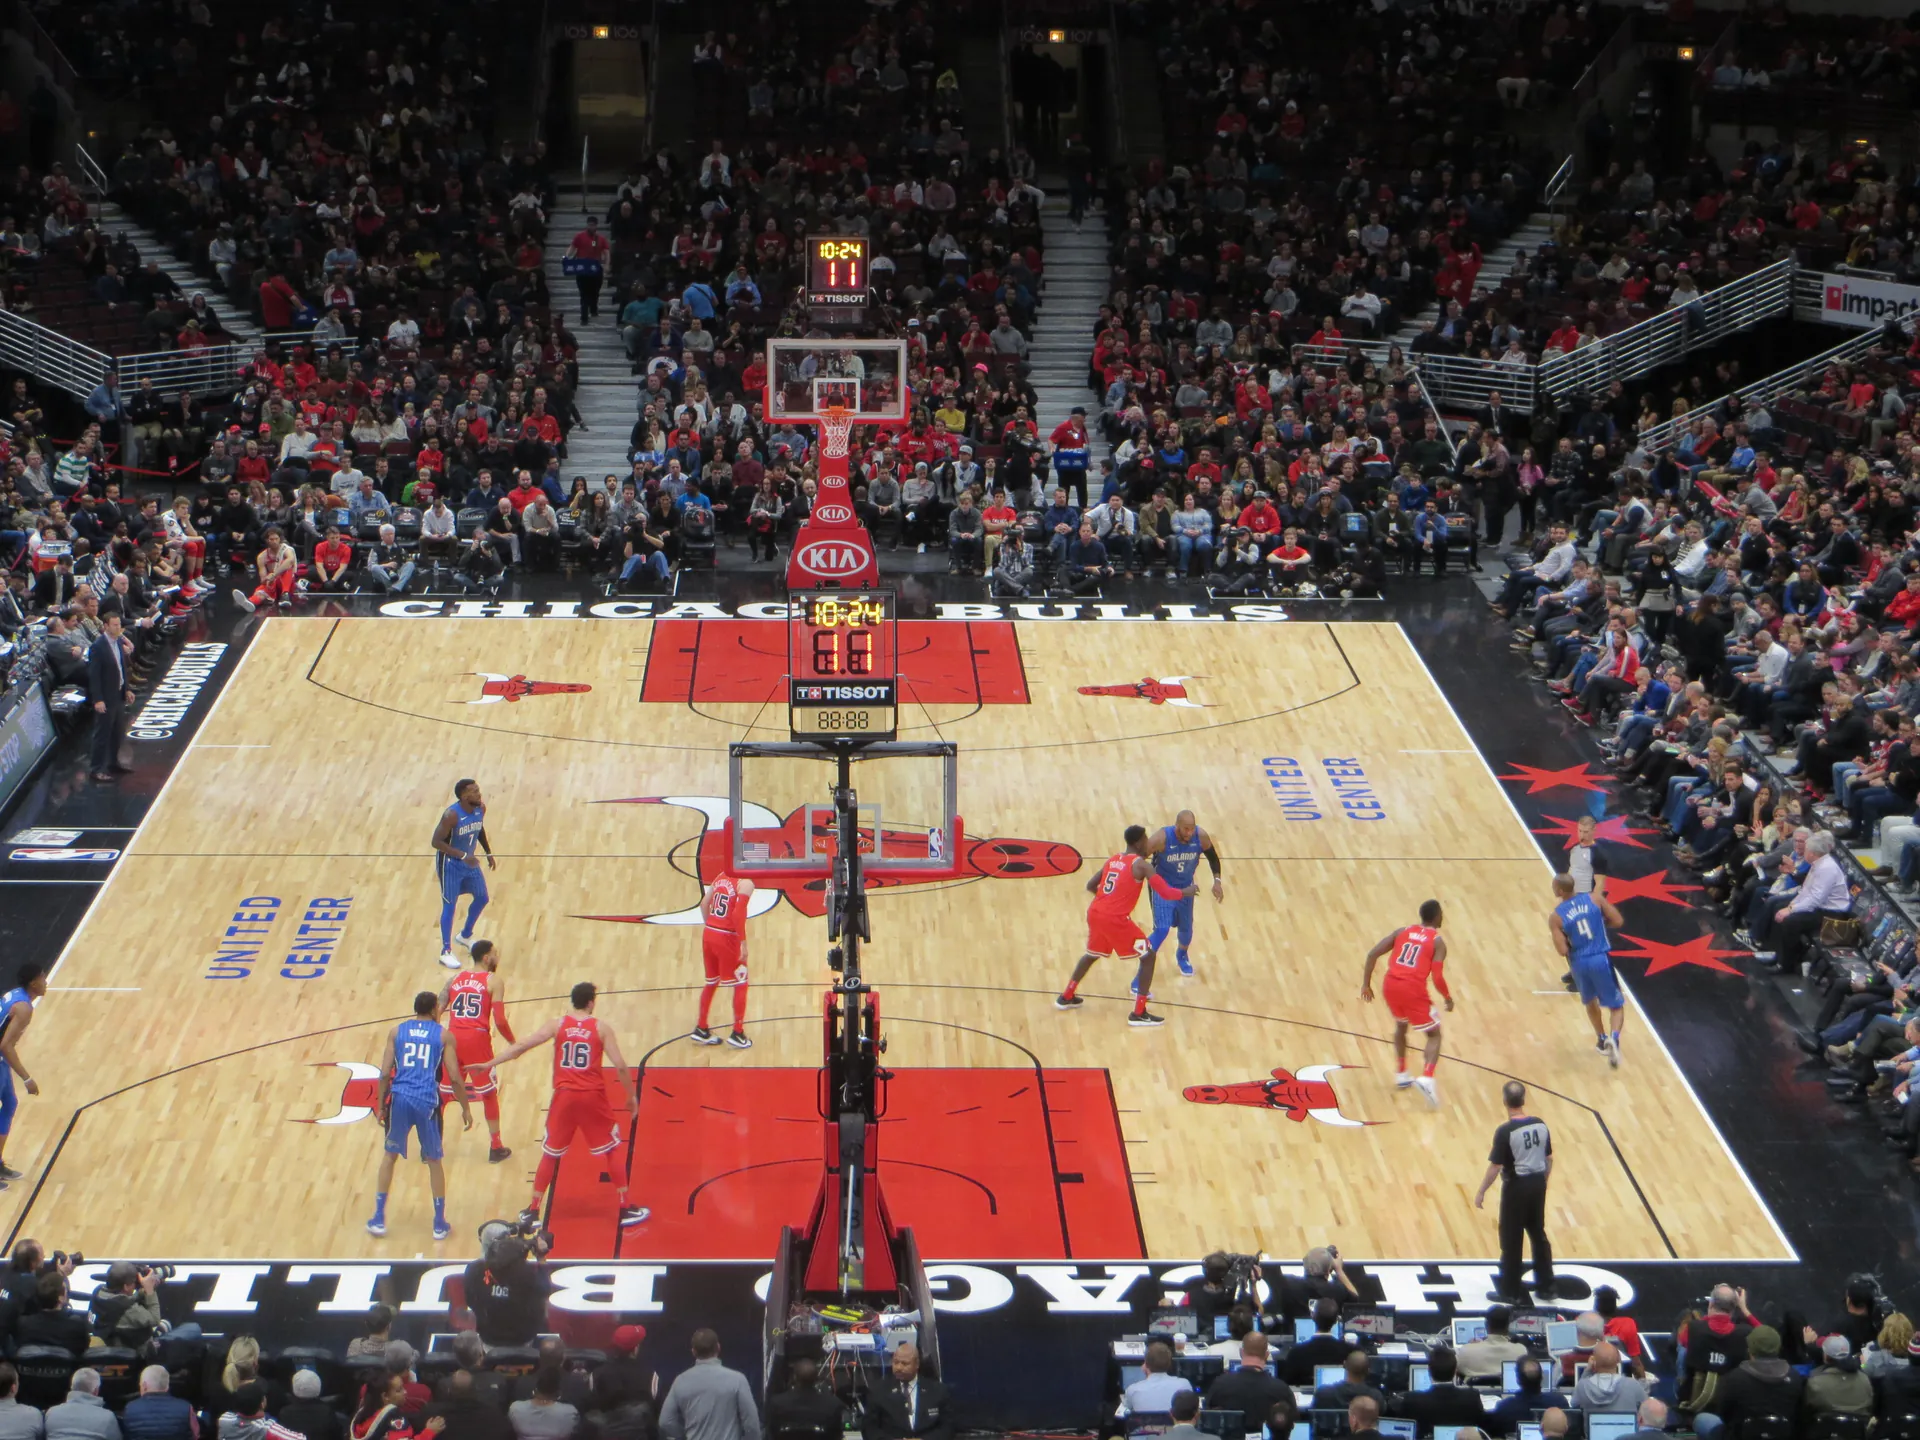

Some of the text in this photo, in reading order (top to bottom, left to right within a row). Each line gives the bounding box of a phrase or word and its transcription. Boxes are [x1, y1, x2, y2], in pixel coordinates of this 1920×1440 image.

[820, 242, 861, 259] 10:24
[830, 262, 856, 286] 11
[825, 295, 866, 303] TISSOT
[826, 478, 842, 486] KIA
[822, 509, 846, 519] KIA
[809, 548, 858, 568] KIA
[815, 601, 881, 627] 10:24
[935, 603, 1289, 620] BULLS
[127, 642, 229, 740] @CHICAGOBULLS
[823, 686, 890, 699] TISSOT
[1261, 757, 1322, 820] UNITED
[1322, 757, 1386, 820] CENTER
[1166, 852, 1198, 862] ORLANDO
[1177, 862, 1185, 873] 5
[1103, 871, 1118, 895] 5
[710, 892, 731, 918] 15
[204, 896, 282, 980] UNITED
[279, 897, 354, 980] CENTER
[1577, 918, 1593, 940] 4
[1396, 942, 1421, 968] 11
[451, 992, 483, 1019] 45
[403, 1042, 431, 1069] 24
[560, 1041, 591, 1069] 16
[1523, 1129, 1540, 1150] 24
